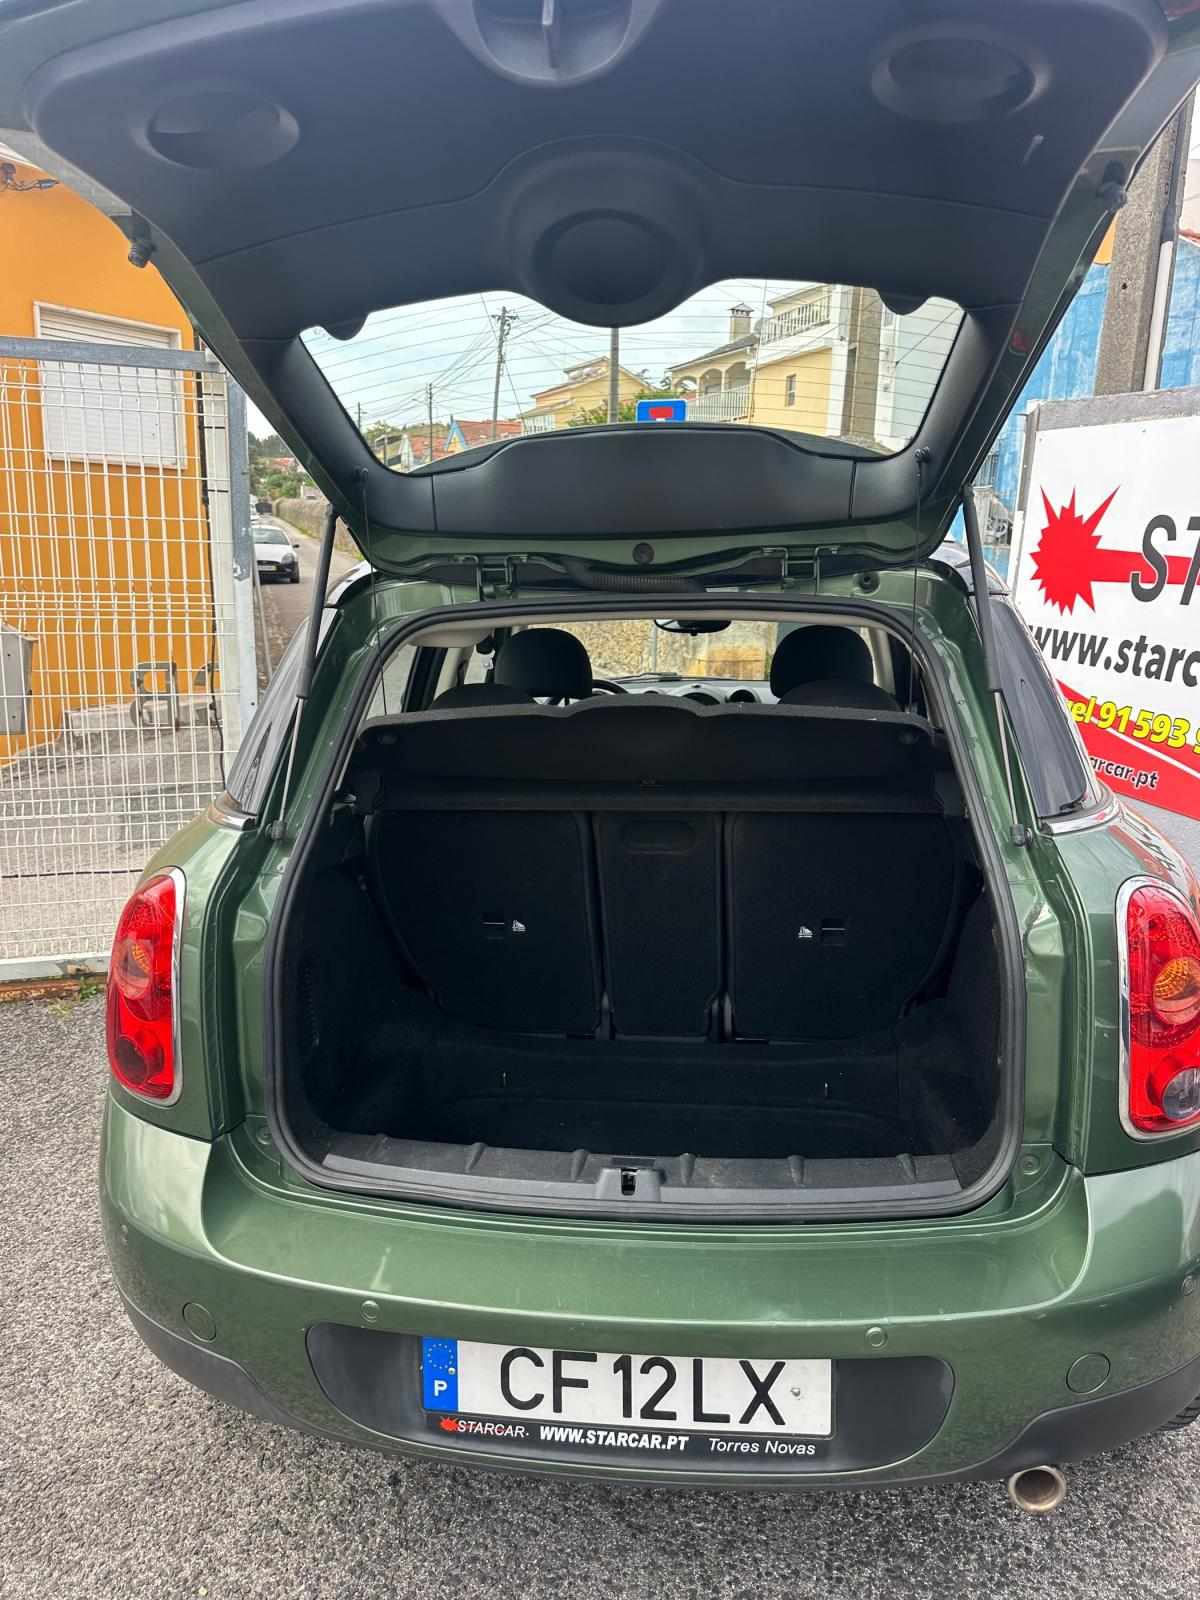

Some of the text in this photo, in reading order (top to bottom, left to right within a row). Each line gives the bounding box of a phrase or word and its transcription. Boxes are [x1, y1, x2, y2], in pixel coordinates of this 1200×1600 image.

[1066, 695, 1097, 724] el
[1096, 701, 1133, 734] 91
[1131, 709, 1190, 749] 593
[434, 1380, 448, 1396] P
[540, 1426, 689, 1450] WWW.STARCAR.PT
[709, 1438, 760, 1453] Torres
[764, 1440, 816, 1455] Novas
